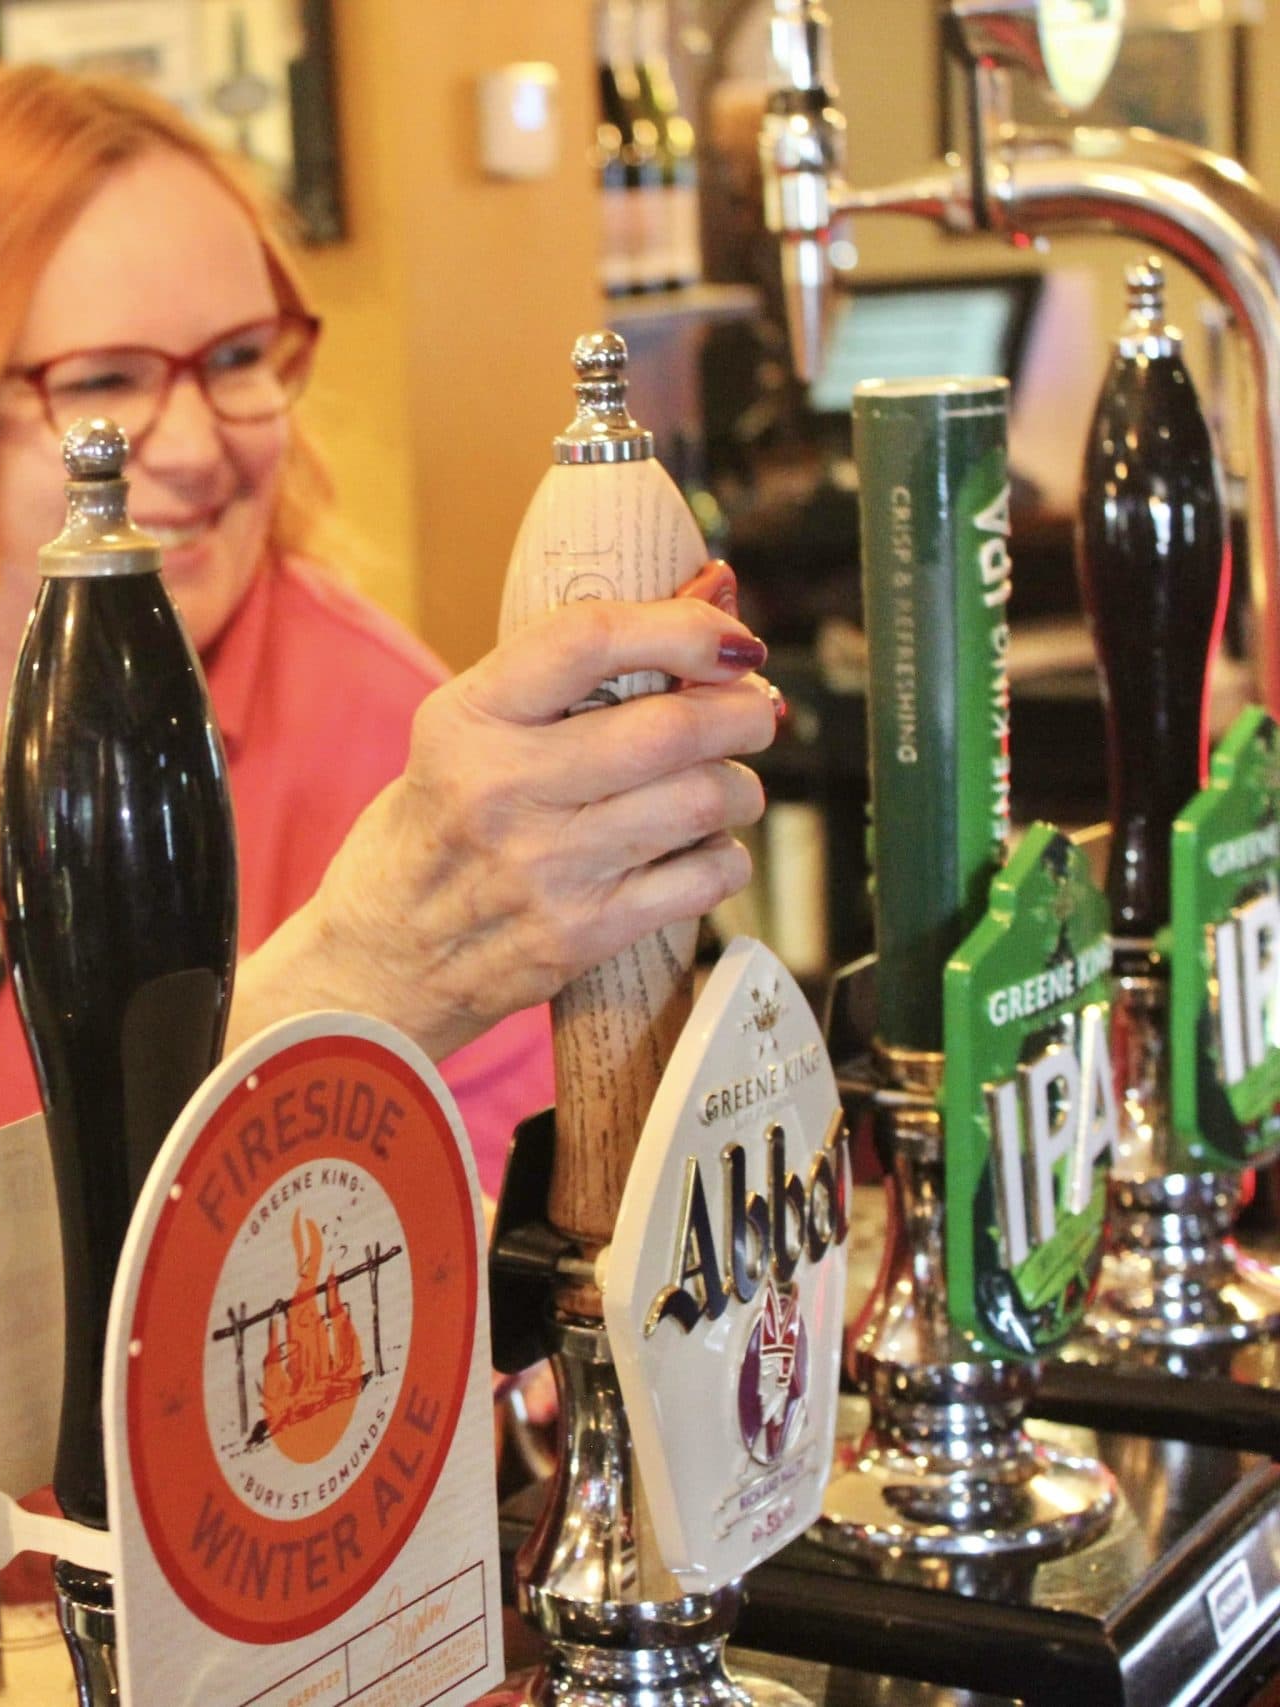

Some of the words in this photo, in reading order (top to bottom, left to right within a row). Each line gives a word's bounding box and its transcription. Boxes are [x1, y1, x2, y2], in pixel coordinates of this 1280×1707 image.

[890, 485, 913, 564] CRISP
[892, 571, 914, 588] &
[894, 596, 918, 764] REFRESHING
[988, 957, 1076, 1026] GREENE
[704, 1068, 777, 1122] GREENE
[784, 1045, 821, 1088] KING
[197, 1078, 405, 1234] FIRESIDE
[984, 1003, 1118, 1270] IPA
[250, 1171, 313, 1236] GREENE
[321, 1168, 360, 1193] KING
[189, 1492, 362, 1602] WINTER
[373, 1385, 440, 1530] ALE
[244, 1475, 282, 1509] BURY
[292, 1491, 310, 1510] ST
[320, 1408, 386, 1500] EDMUNDS
